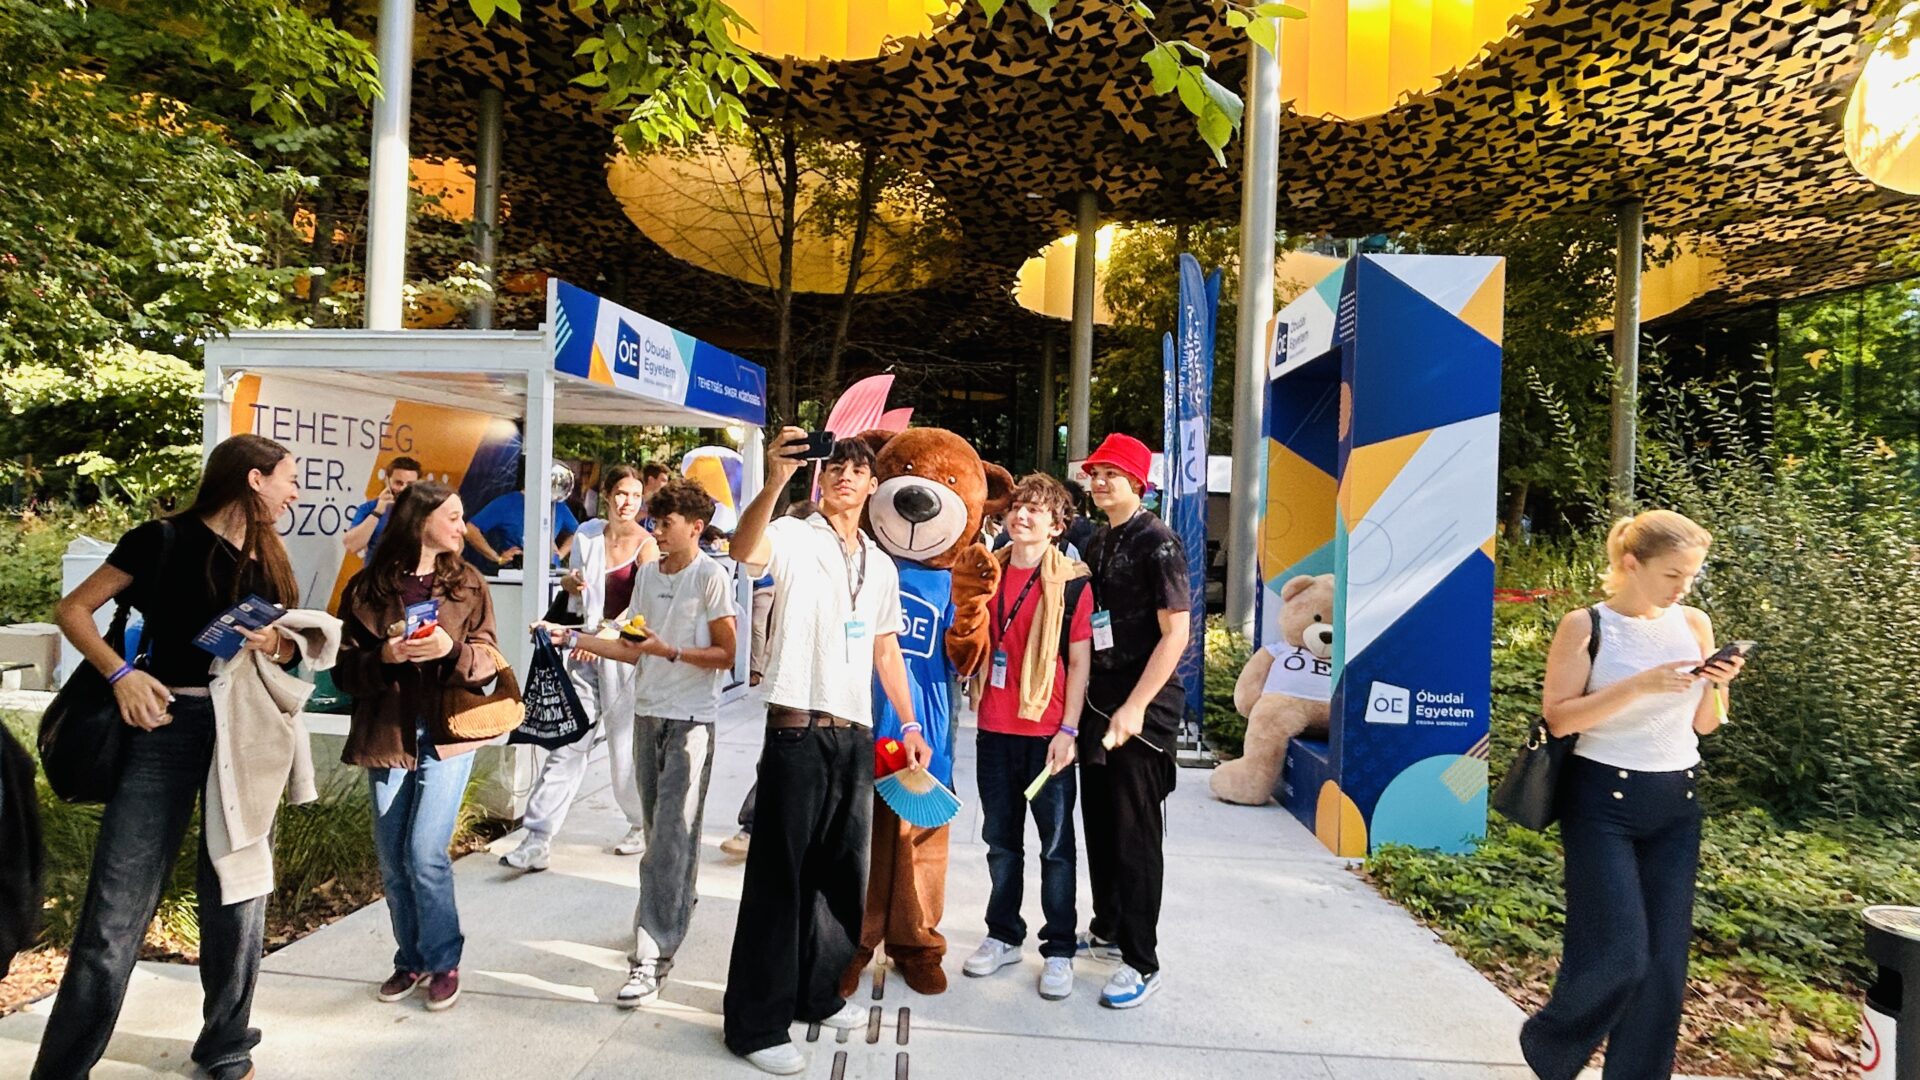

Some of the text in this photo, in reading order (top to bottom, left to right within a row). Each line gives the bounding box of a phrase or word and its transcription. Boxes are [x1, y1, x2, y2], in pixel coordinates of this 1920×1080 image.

[618, 333, 639, 367] ÓE
[644, 336, 671, 360] Óbudai
[644, 356, 676, 379] Egyetem
[1374, 692, 1403, 714] ÓE
[1416, 688, 1464, 704] Óbudai
[1415, 704, 1474, 719] Egyetem
